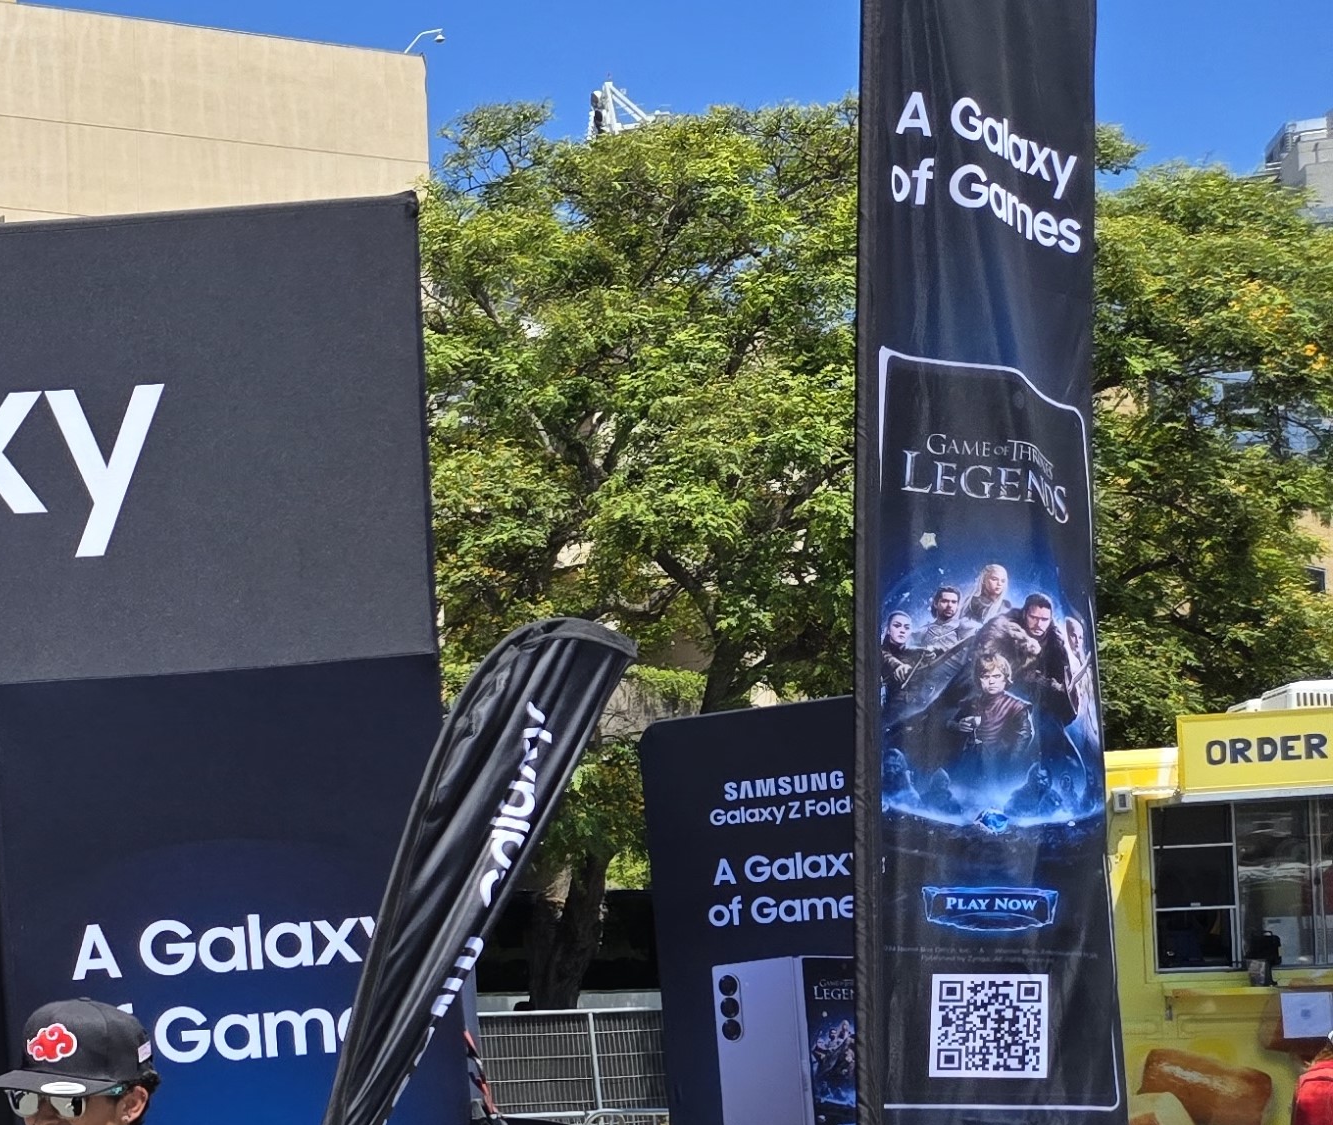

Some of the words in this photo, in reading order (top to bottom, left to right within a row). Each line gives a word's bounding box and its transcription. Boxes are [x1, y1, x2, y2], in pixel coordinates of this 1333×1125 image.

[895, 91, 933, 137] A
[950, 97, 1077, 199] Galaxy
[891, 158, 934, 205] of
[949, 165, 1081, 254] Games
[926, 433, 991, 457] GAME
[901, 450, 1069, 524] LEGENDS
[1205, 733, 1328, 766] ORDER
[724, 770, 845, 801] SAMSUNG
[709, 805, 785, 826] Galaxy
[788, 801, 801, 819] Z
[805, 795, 853, 818] Fold
[713, 856, 737, 886] A
[708, 898, 743, 927] of
[946, 896, 988, 910] PLAY
[995, 897, 1038, 911] NOW
[72, 923, 123, 981] A
